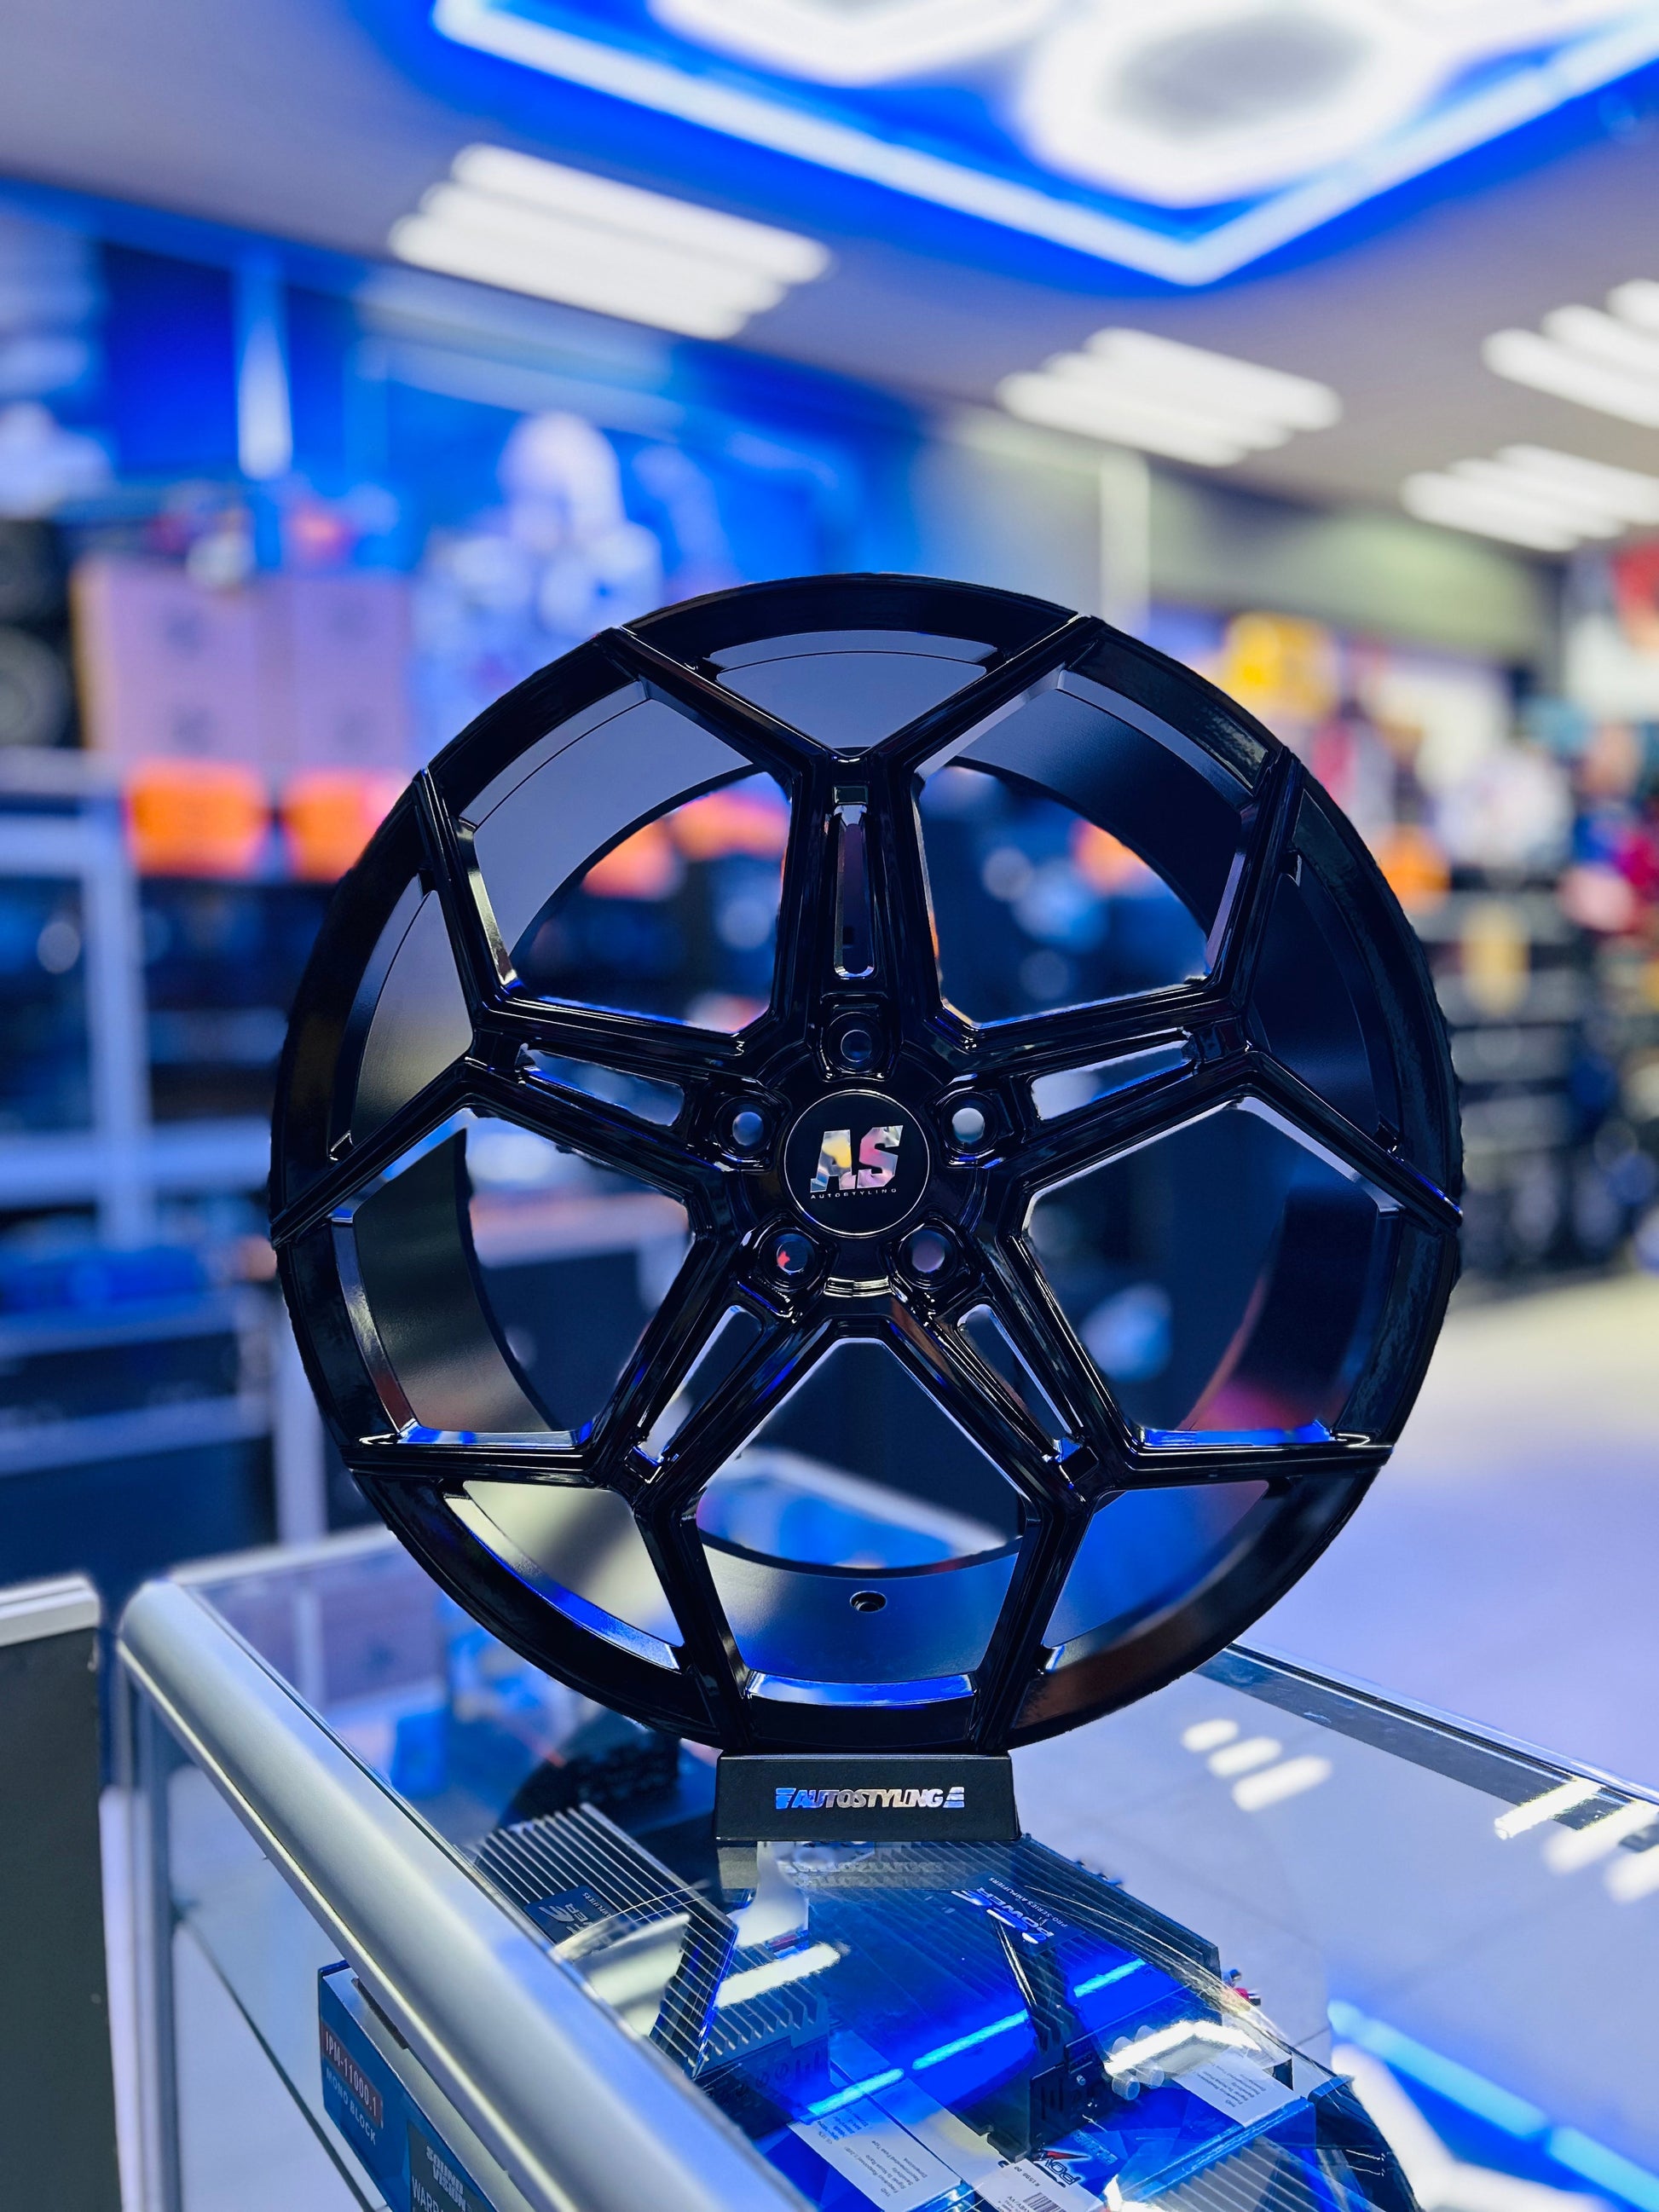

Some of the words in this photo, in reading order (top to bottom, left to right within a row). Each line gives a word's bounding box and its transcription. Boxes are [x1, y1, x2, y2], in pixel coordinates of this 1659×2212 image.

[810, 1125, 904, 1193] AS
[811, 1188, 897, 1199] AUTOSTYLING
[792, 1788, 944, 1809] AUTOSTYLING
[989, 1877, 1028, 1902] AMPLIFIERS
[977, 1886, 1055, 1938] POWER
[1027, 1900, 1068, 1928] PRO-SERIES
[326, 2066, 349, 2105] MONO
[350, 2099, 376, 2146] BLOCK
